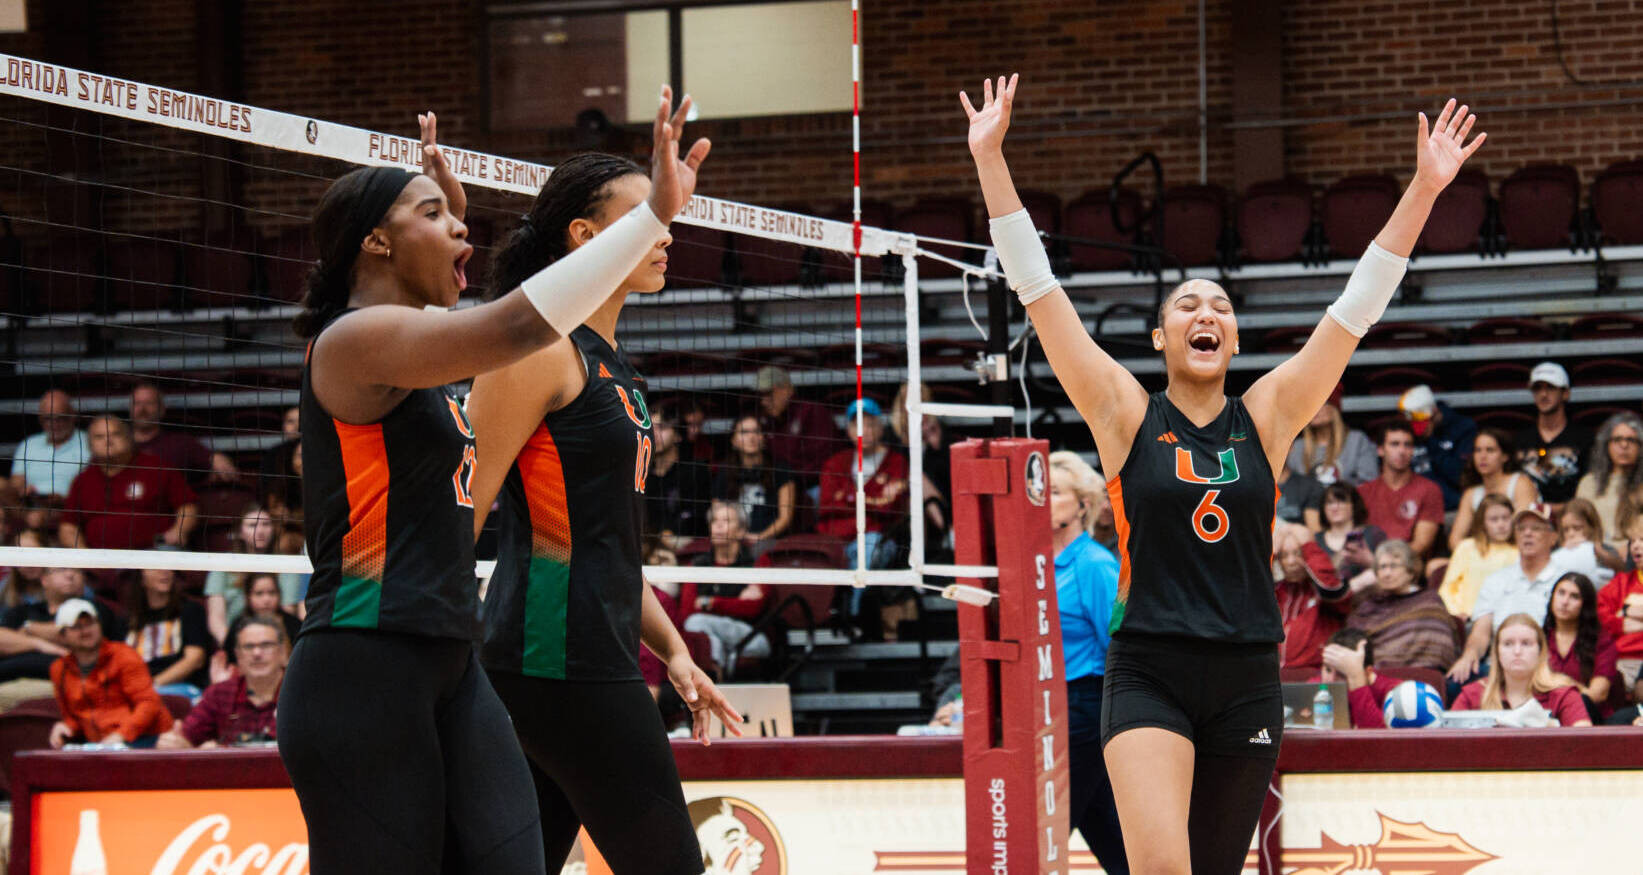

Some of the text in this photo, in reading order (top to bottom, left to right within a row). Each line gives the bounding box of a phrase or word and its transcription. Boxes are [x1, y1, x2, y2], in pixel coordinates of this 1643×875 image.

[78, 72, 137, 110] STATE
[147, 87, 251, 133] SEMINOLES
[369, 134, 424, 166] FLORID
[442, 148, 488, 179] STATE
[720, 202, 756, 229] STATE
[635, 430, 651, 494] 10
[1175, 446, 1240, 485] U
[1191, 489, 1230, 543] 6
[1034, 554, 1059, 875] SEMINOL
[988, 778, 1008, 838] sports
